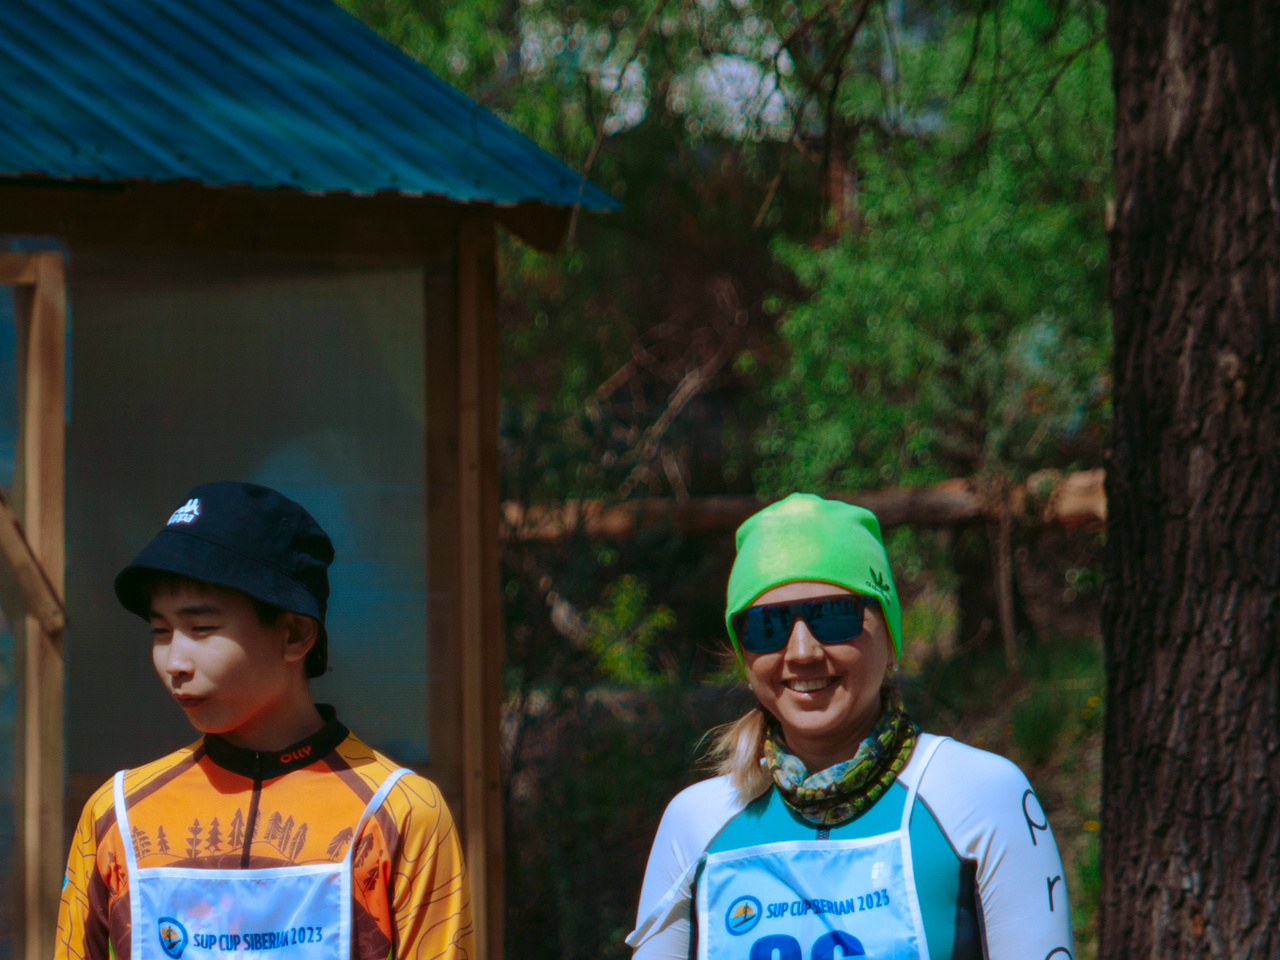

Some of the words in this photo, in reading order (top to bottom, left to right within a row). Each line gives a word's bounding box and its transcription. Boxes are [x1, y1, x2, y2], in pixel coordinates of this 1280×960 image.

[280, 744, 311, 763] OLLY
[766, 902, 789, 919] SUP
[790, 900, 811, 917] CUP
[857, 888, 890, 912] 2023
[193, 934, 217, 951] SUP
[219, 934, 241, 952] CUP
[291, 926, 323, 945] 2023
